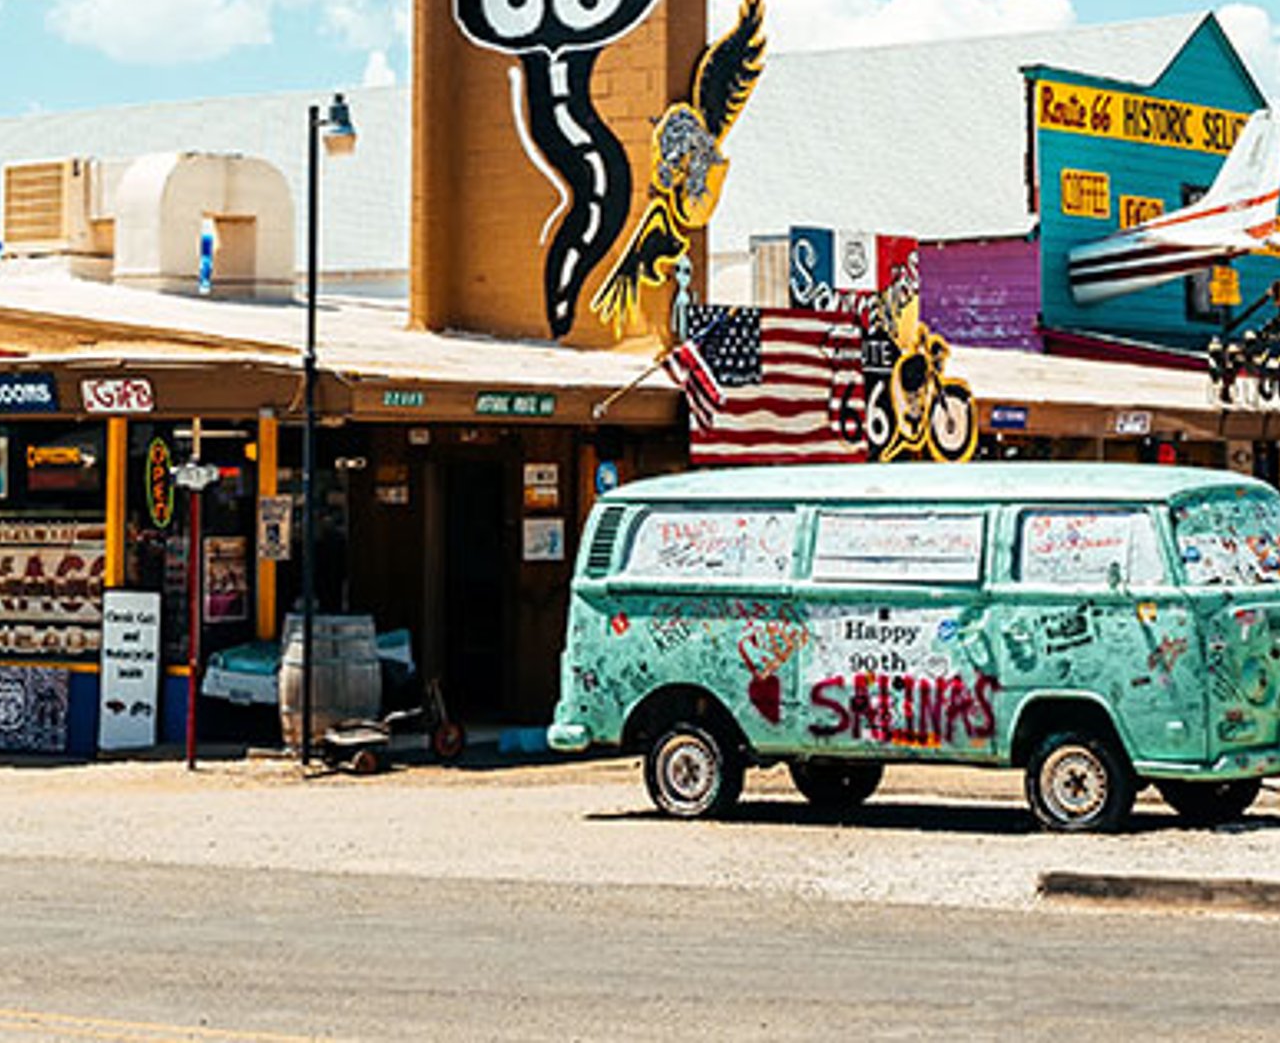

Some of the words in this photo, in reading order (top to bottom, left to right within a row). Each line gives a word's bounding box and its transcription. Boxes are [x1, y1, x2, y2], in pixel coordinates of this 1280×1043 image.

[1041, 86, 1087, 128] Route
[1090, 94, 1111, 132] 66
[1123, 98, 1193, 145] HISTORIC
[840, 381, 889, 446] 66
[844, 621, 919, 645] Happy
[849, 652, 907, 672] 90th
[808, 667, 1000, 745] SALINAS
